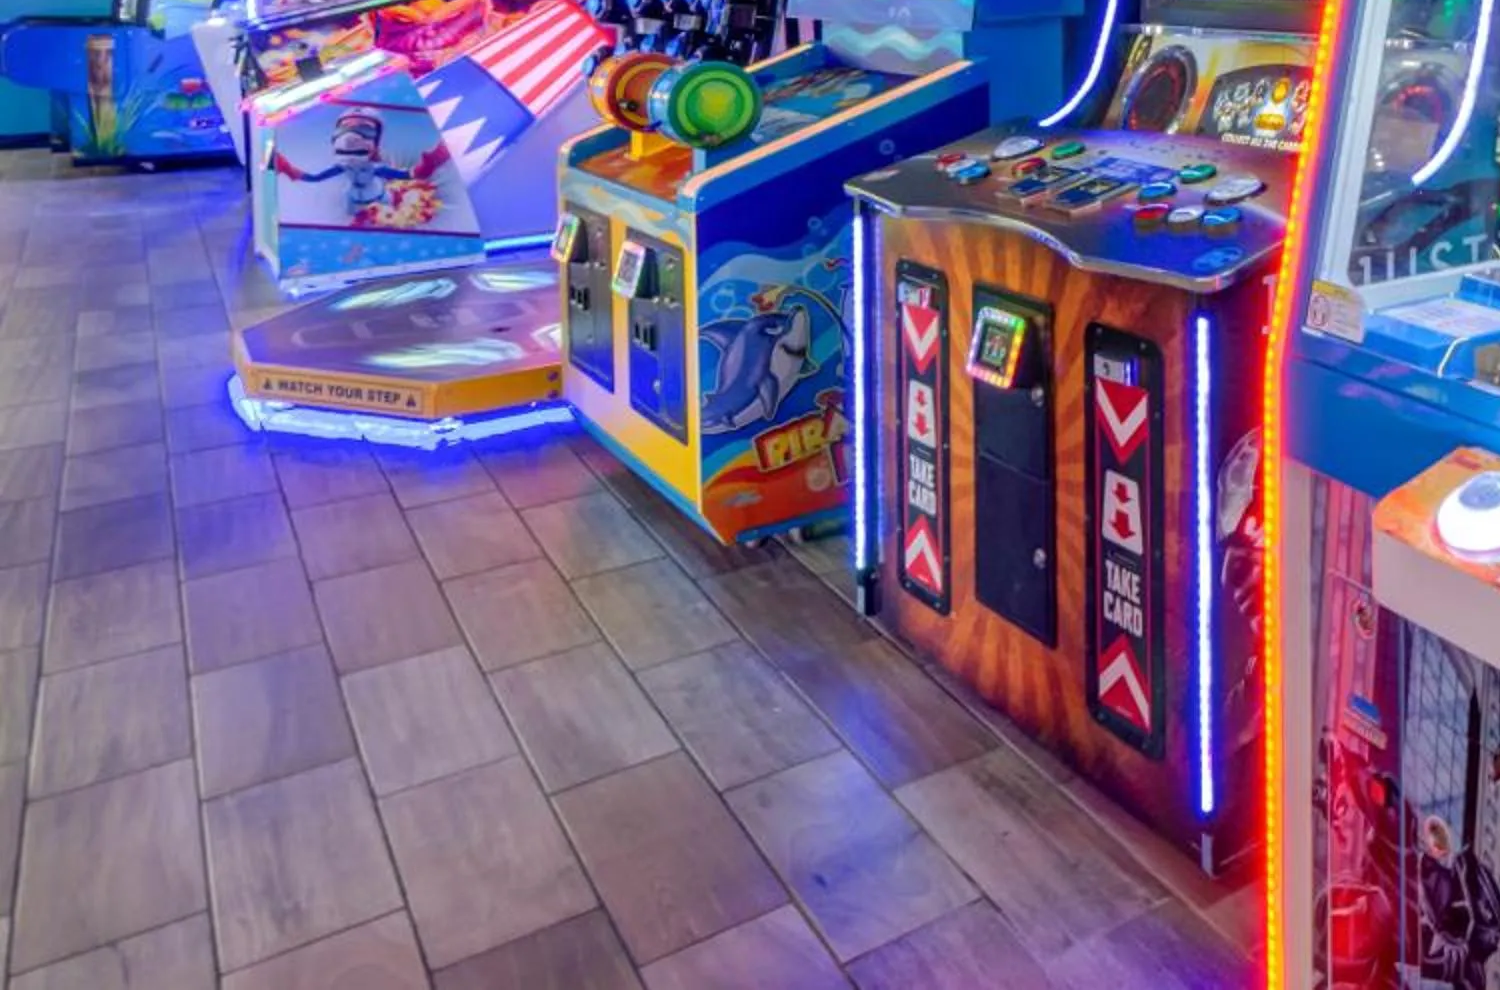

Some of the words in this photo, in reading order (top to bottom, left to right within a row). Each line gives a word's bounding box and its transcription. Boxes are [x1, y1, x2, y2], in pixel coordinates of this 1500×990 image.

[277, 379, 323, 396] WATCH
[326, 385, 364, 400] YOUR
[367, 389, 401, 403] STEP
[909, 453, 936, 489] TAKE
[909, 481, 937, 517] CARD
[1105, 559, 1141, 606] TAKE
[1103, 590, 1143, 639] CARD
